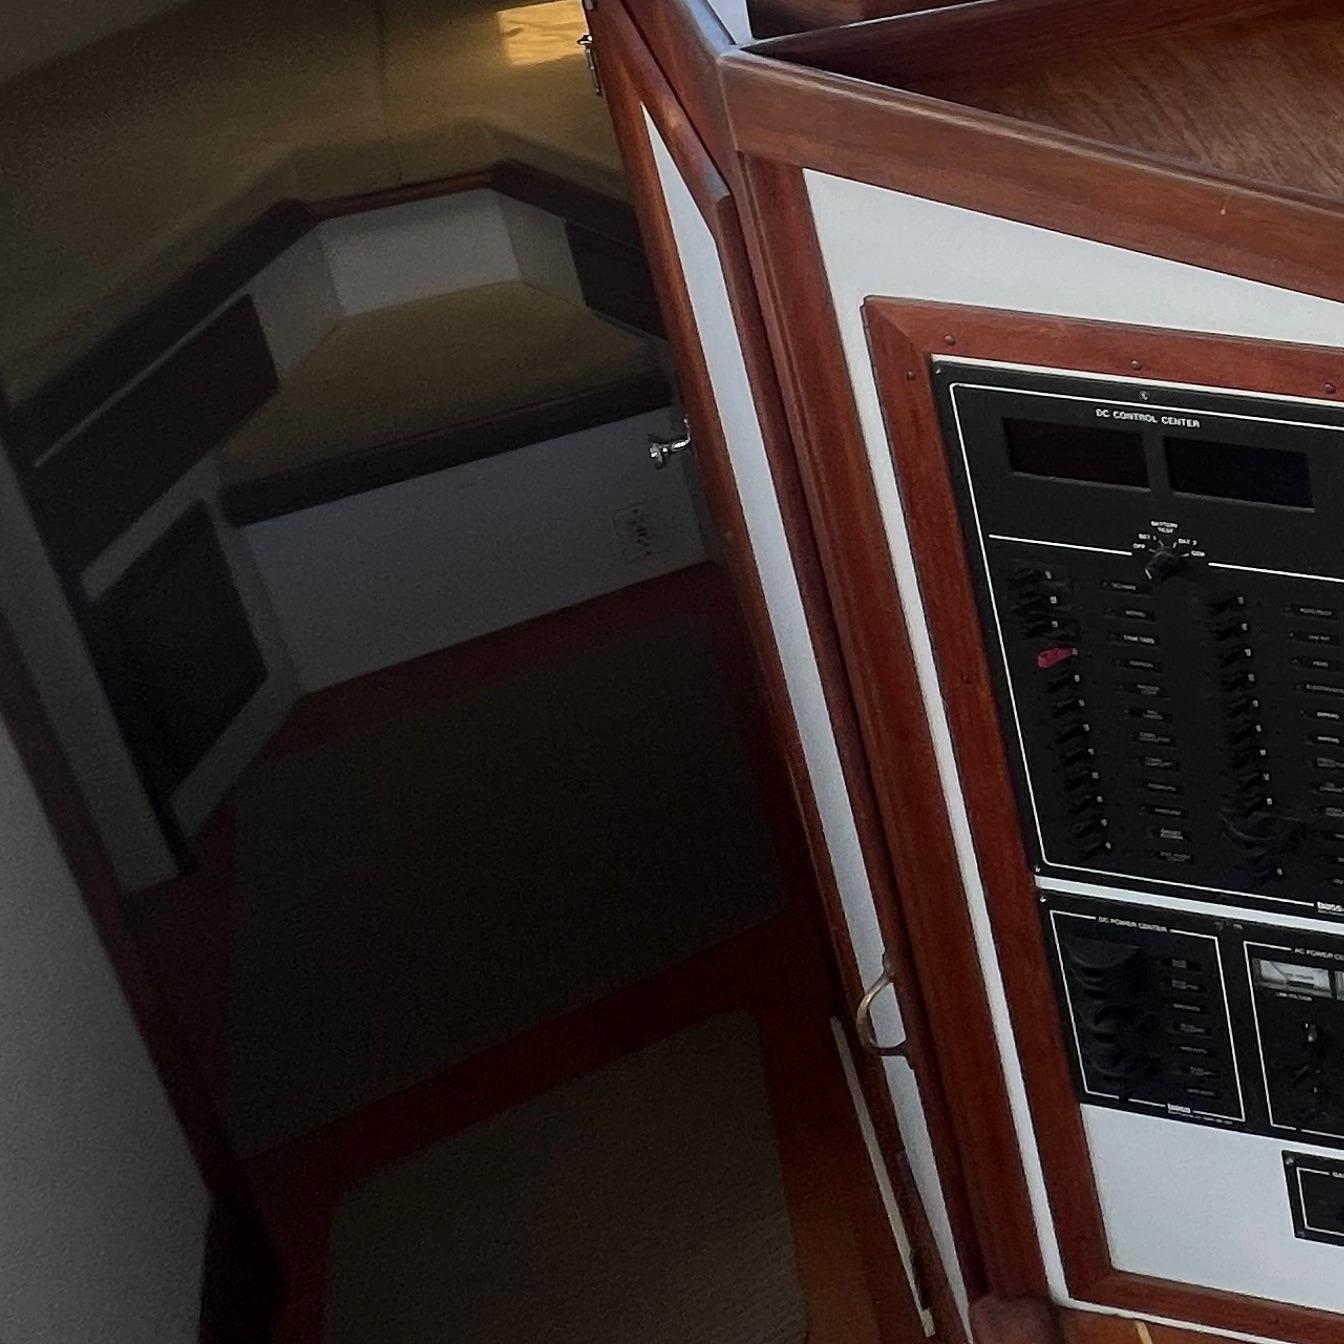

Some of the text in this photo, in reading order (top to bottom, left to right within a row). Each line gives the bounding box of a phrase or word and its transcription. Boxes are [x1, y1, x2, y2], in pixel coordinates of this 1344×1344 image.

[1095, 408, 1201, 429] DC CONTROL CENTER
